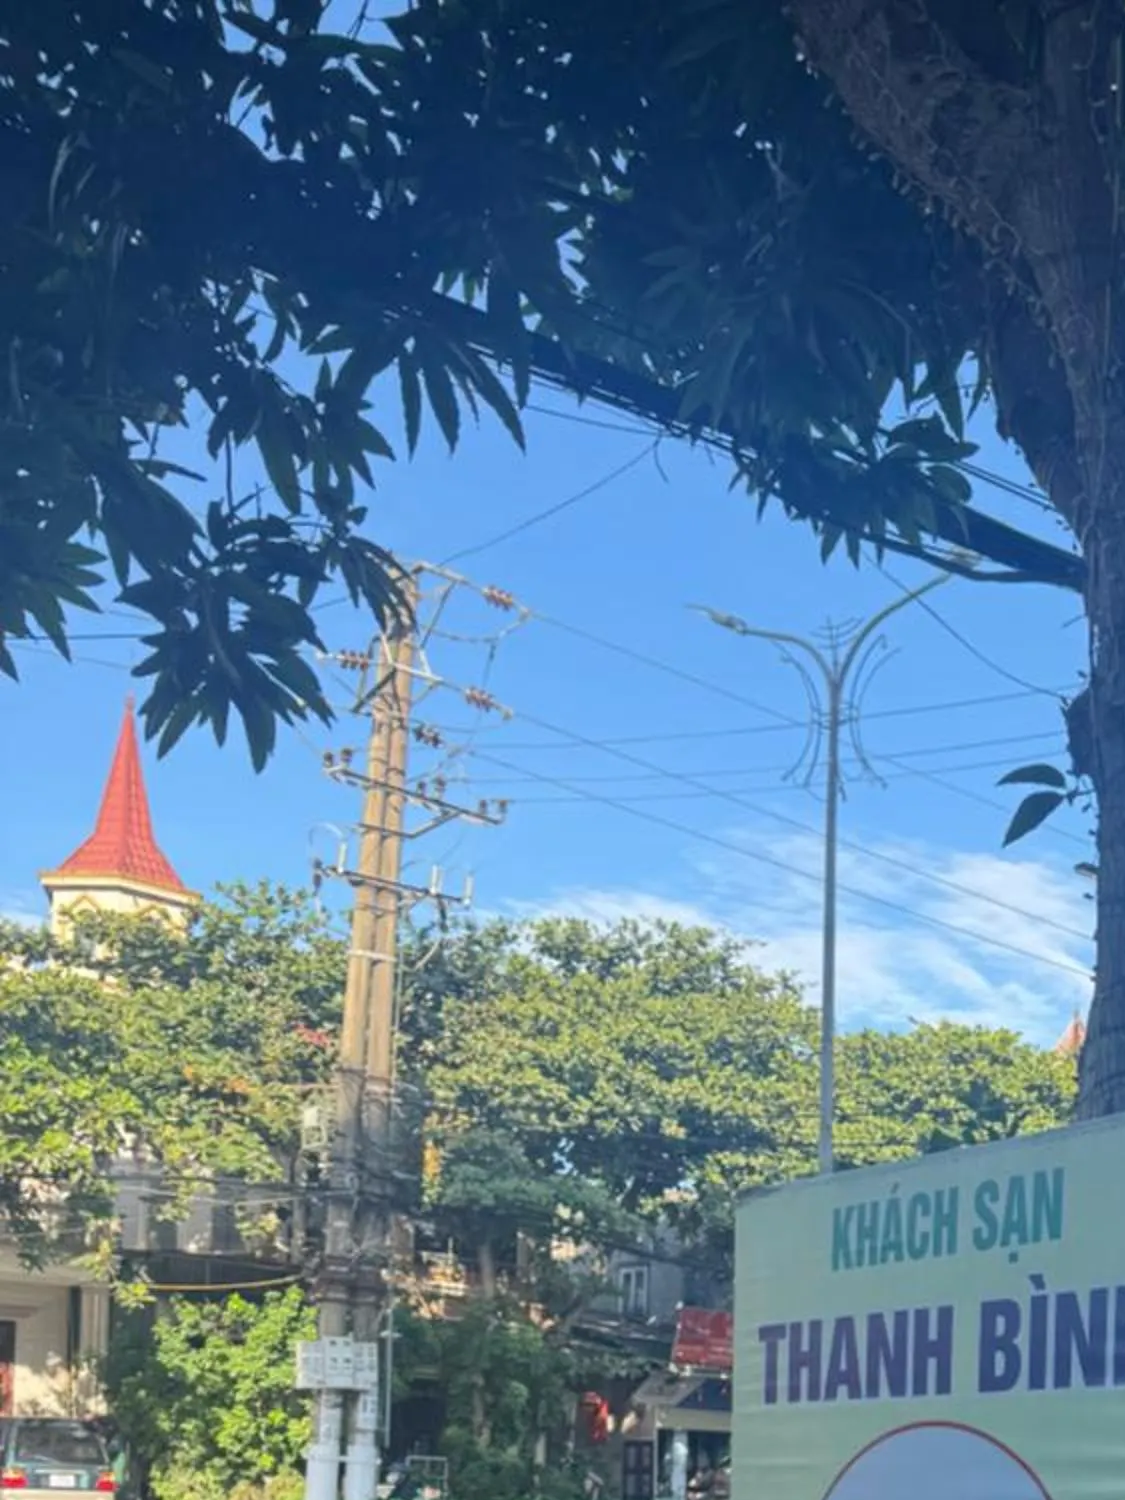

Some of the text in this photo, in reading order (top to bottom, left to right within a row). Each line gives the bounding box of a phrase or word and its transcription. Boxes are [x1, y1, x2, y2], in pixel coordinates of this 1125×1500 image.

[831, 1167, 1065, 1271] KHÁCH SẠN
[758, 1305, 954, 1404] THANH
